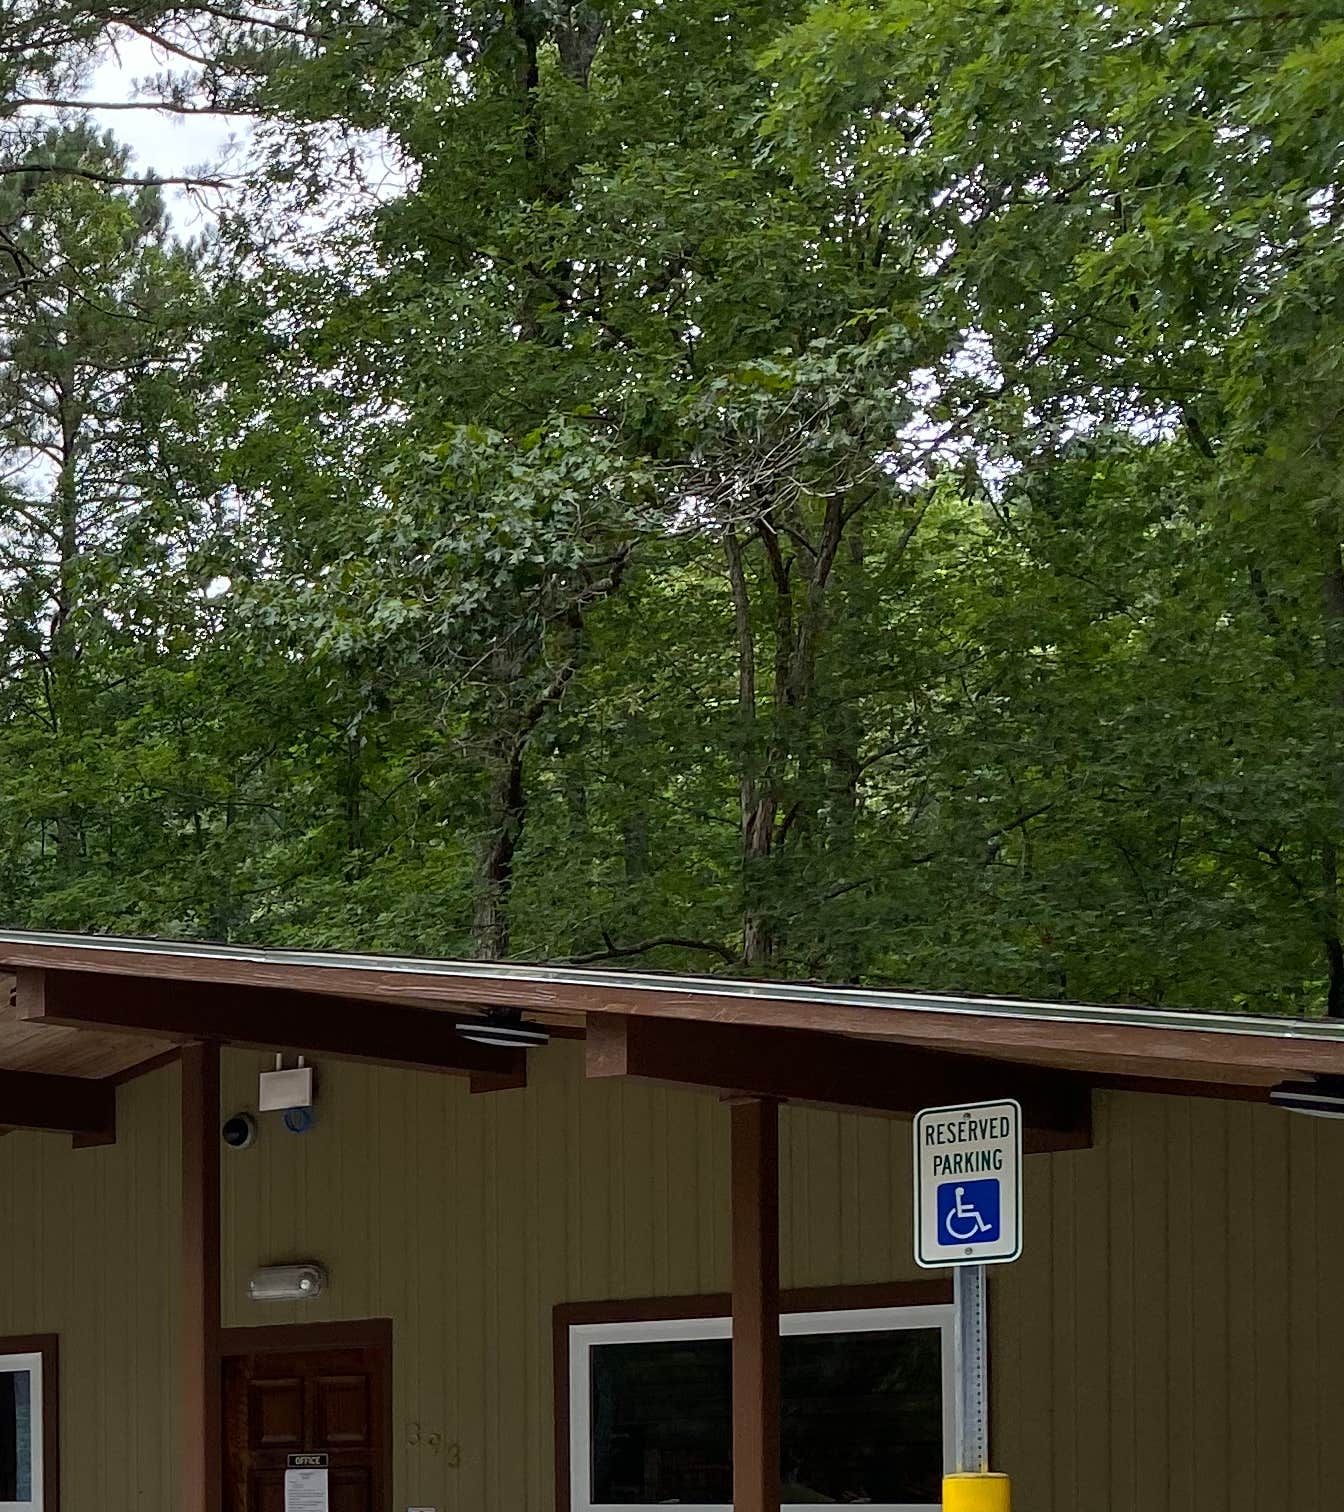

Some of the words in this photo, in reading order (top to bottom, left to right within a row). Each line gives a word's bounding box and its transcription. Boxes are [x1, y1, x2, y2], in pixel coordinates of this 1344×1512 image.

[925, 1116, 1010, 1146] RESERVED
[933, 1148, 1003, 1176] PARKING
[294, 1455, 321, 1466] OFFICE
